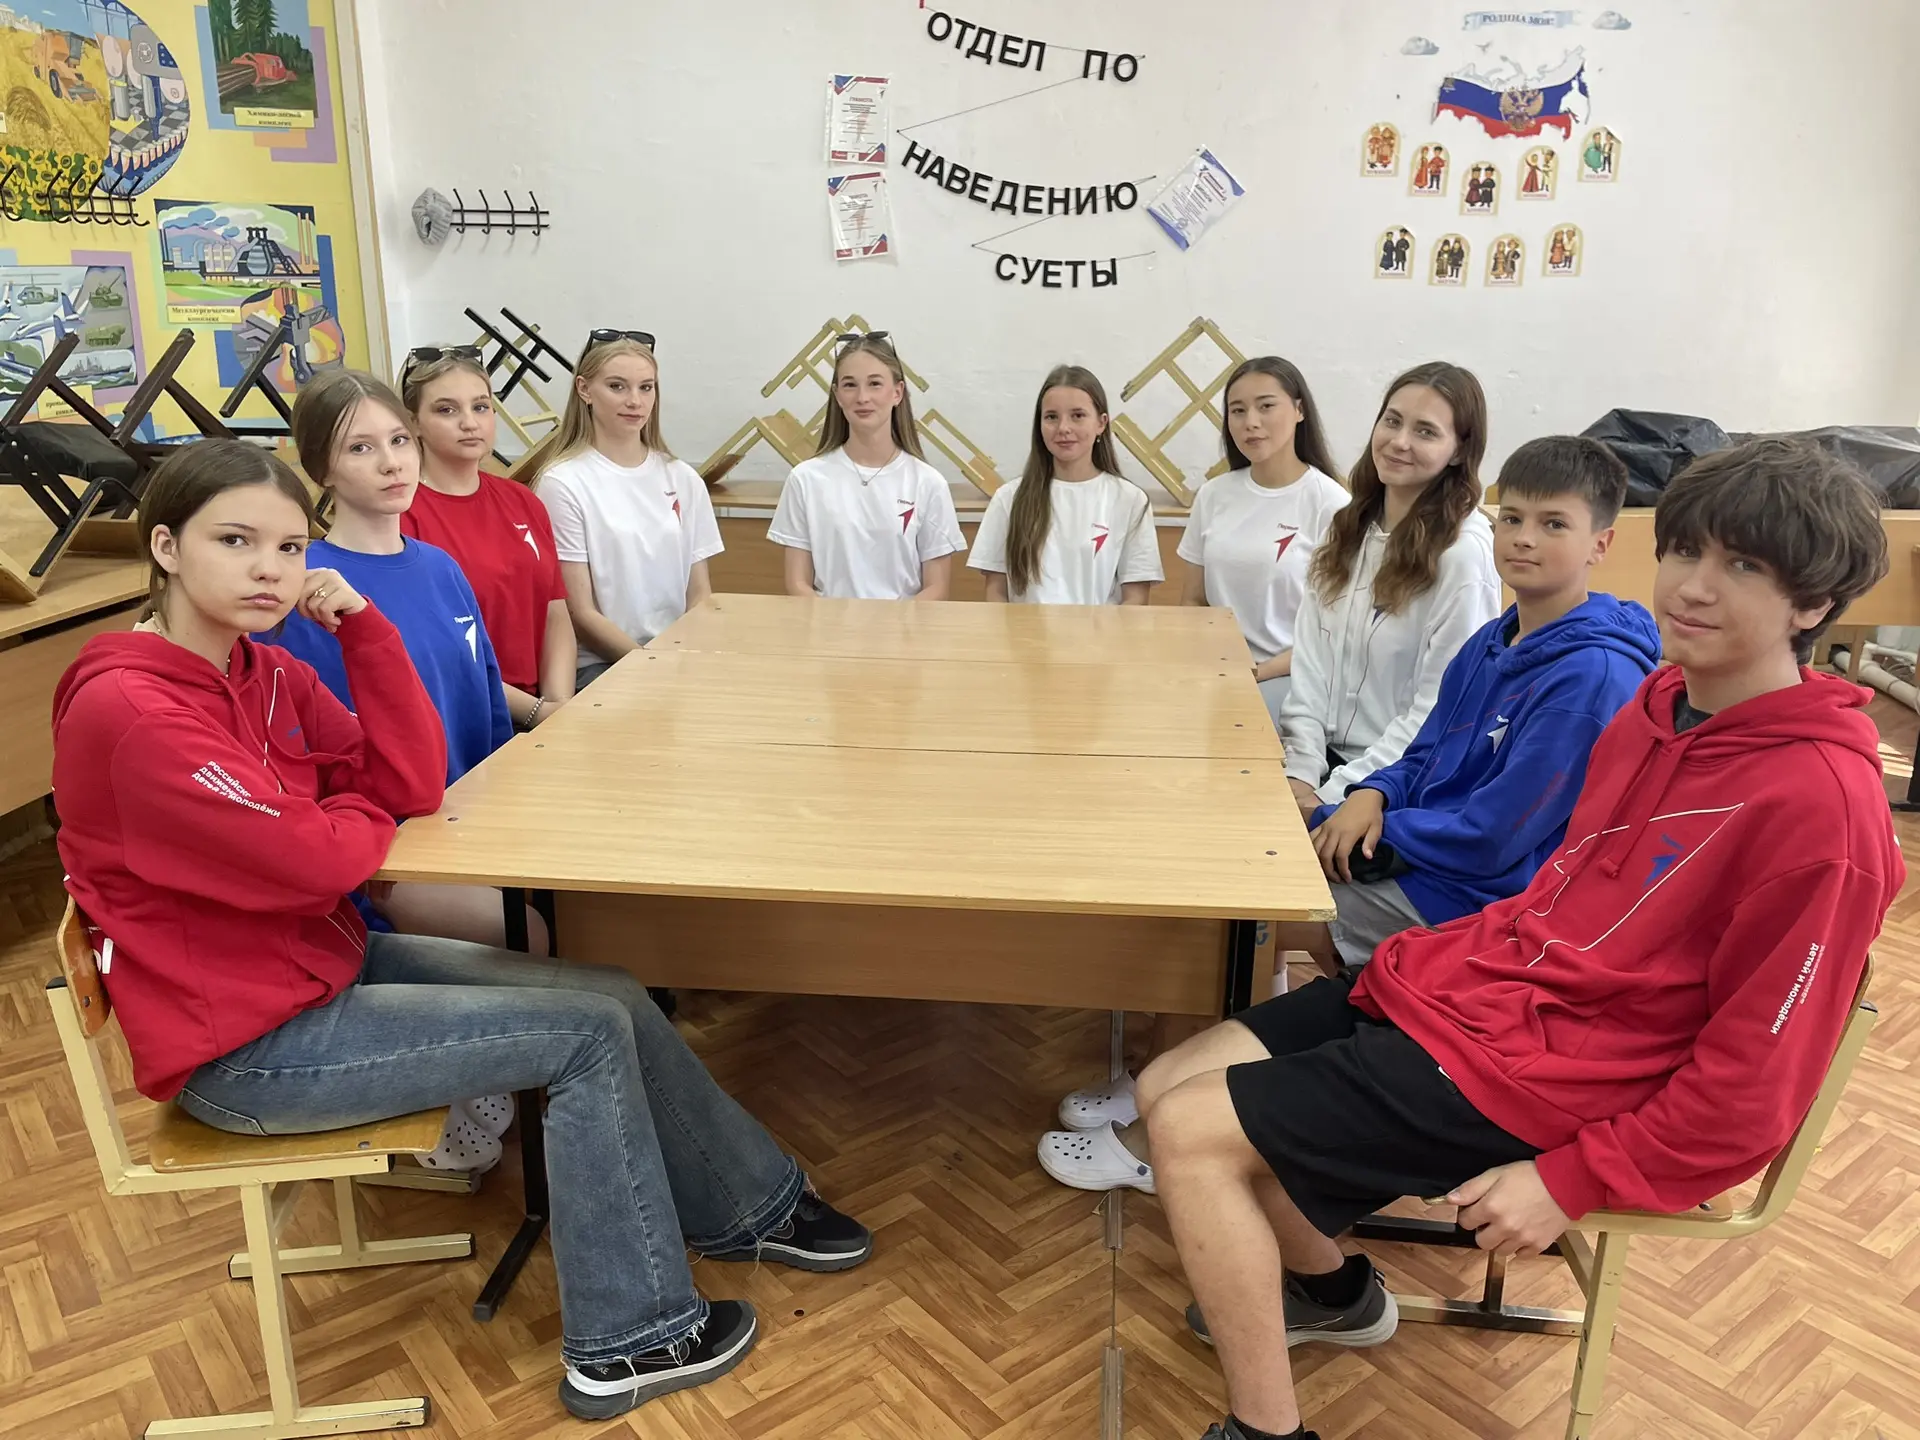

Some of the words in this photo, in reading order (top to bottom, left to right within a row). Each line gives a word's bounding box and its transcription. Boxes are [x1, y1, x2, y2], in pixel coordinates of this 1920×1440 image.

[928, 13, 1045, 71] ОТДЕЛ
[1083, 50, 1137, 82] ПО
[902, 141, 1137, 215] НАВЕДЕНИЮ
[996, 254, 1117, 287] СУЕТЫ
[1796, 973, 1806, 983] и
[1800, 942, 1820, 975] детей
[1770, 982, 1802, 1036] молодёжи
